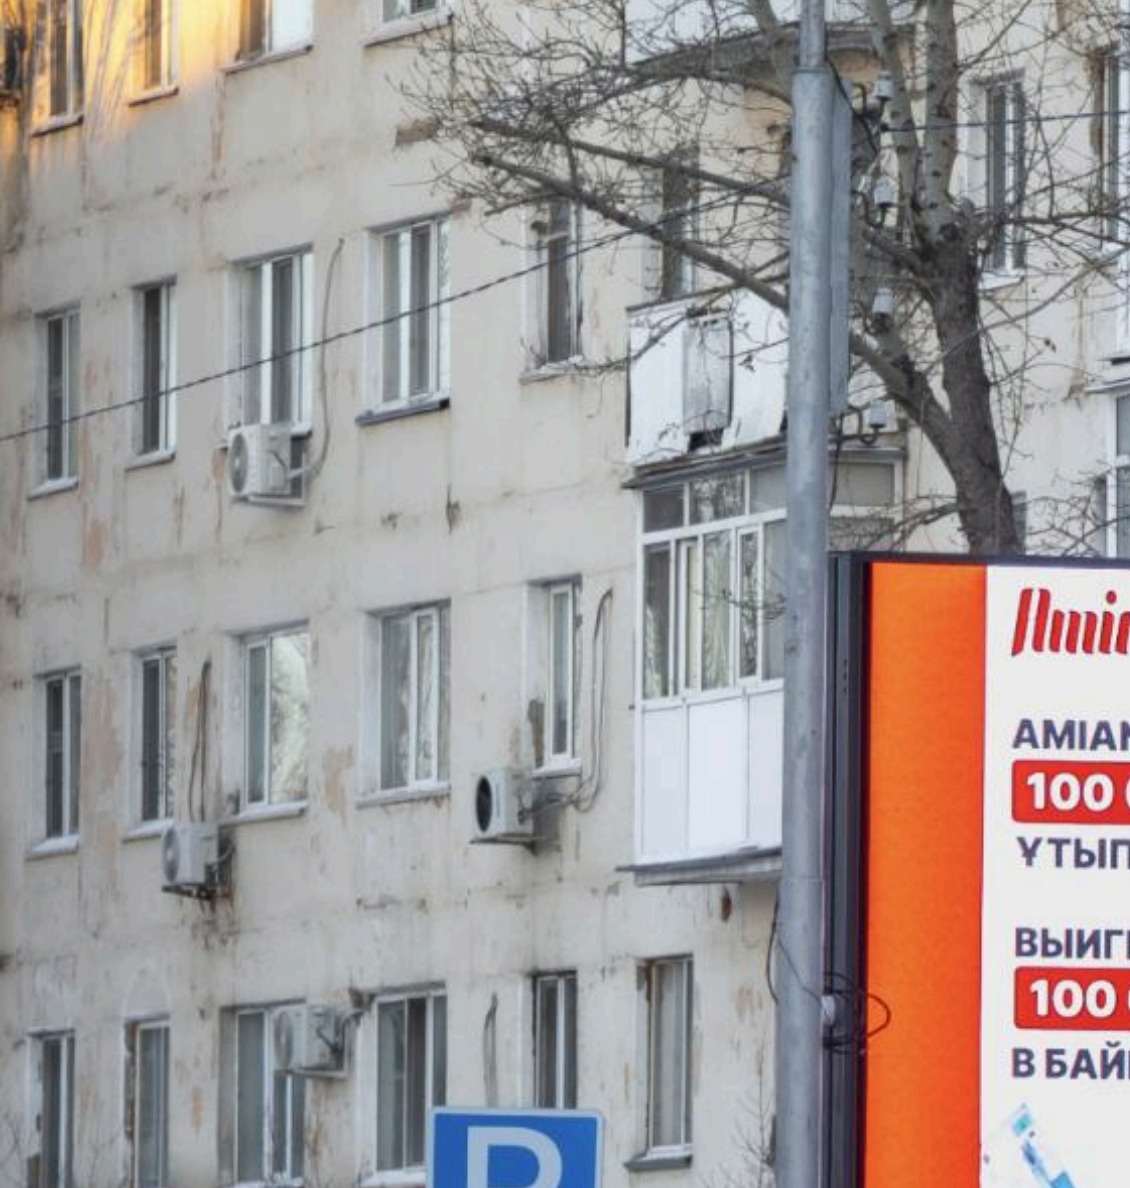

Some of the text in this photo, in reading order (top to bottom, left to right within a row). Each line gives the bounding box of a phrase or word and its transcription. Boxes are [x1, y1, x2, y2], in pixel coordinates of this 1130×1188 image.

[1027, 773, 1114, 811] 100
[1030, 979, 1116, 1017] 100
[1012, 1048, 1035, 1079] В
